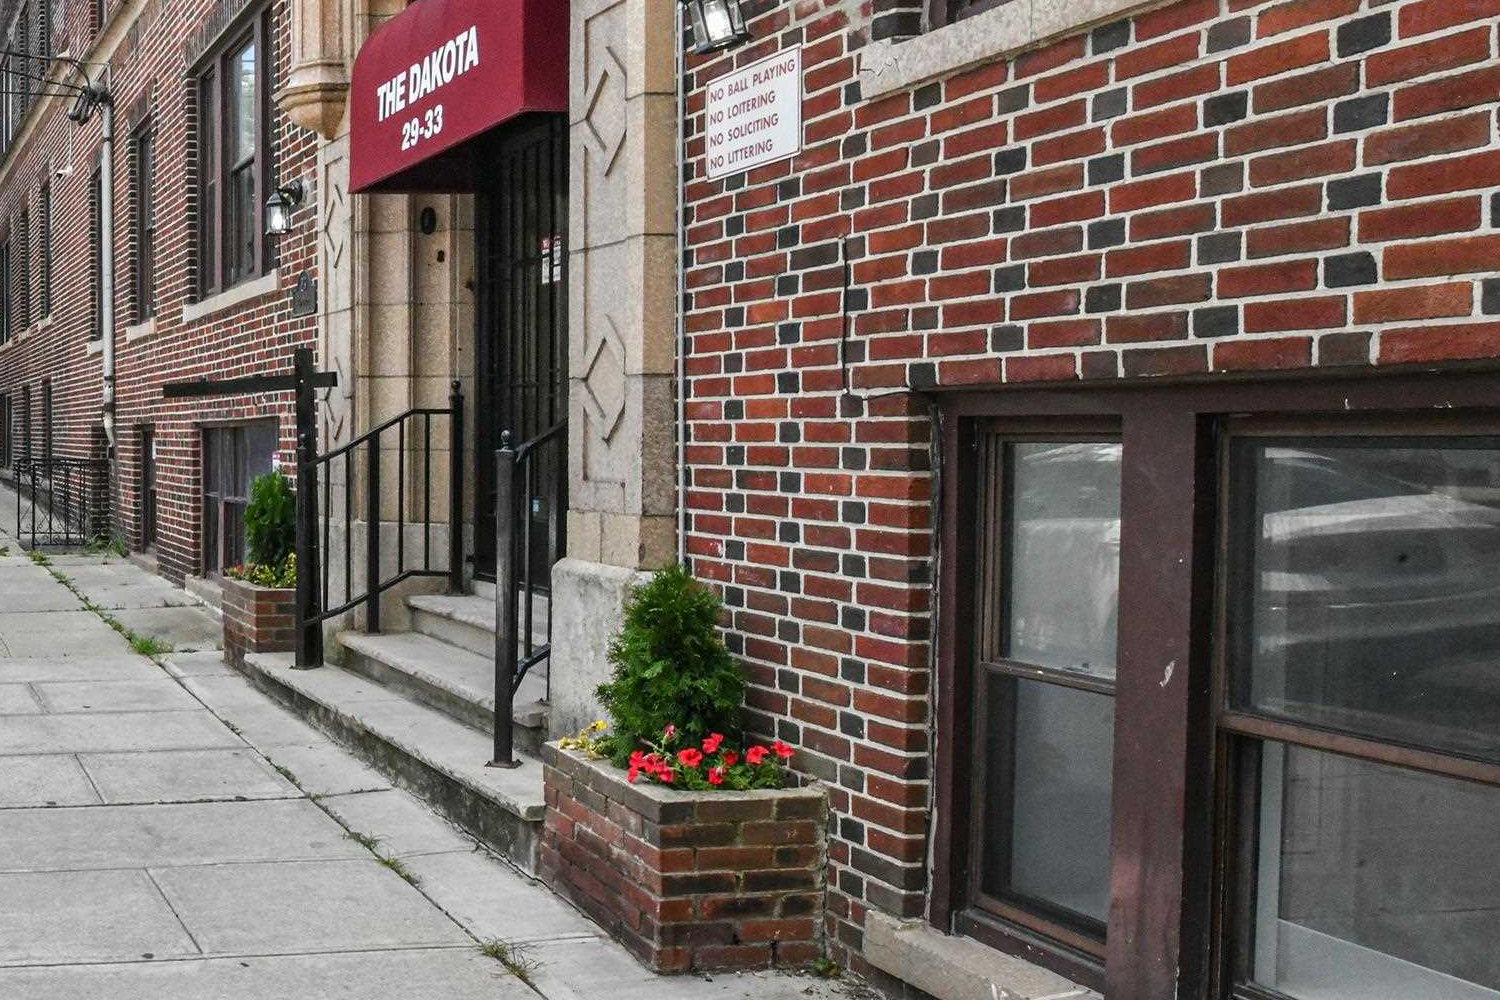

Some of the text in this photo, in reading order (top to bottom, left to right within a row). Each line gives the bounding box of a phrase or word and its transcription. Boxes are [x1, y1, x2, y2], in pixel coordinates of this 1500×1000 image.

[377, 25, 479, 122] THE DAKOTA
[709, 59, 795, 104] NO BALL PLAYING
[401, 104, 443, 152] 29-33
[709, 90, 776, 126] NO LOITERING
[709, 113, 779, 148] NO SOLICITING
[710, 139, 773, 170] NO LITTERING
